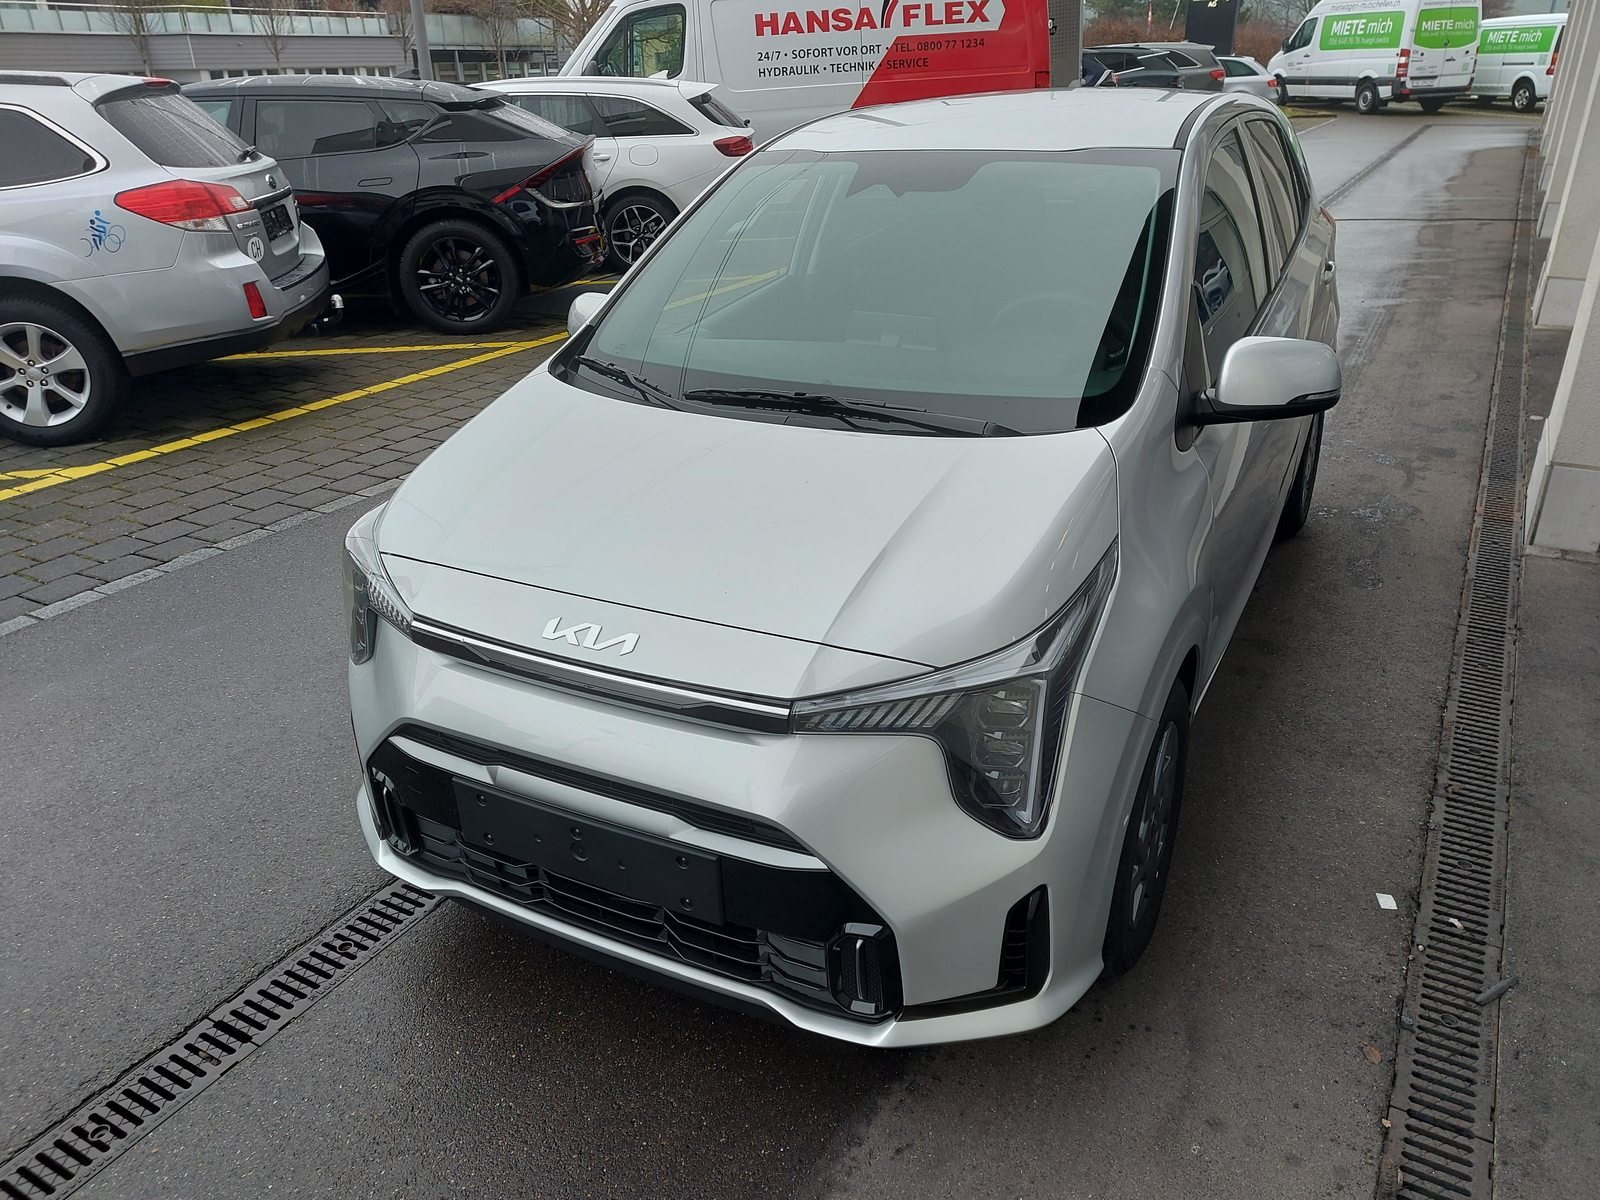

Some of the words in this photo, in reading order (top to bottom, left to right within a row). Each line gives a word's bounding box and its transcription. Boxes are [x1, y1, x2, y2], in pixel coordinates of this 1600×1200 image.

[754, 7, 878, 36] HANSA
[902, 0, 990, 28] FLEX
[1331, 19, 1367, 36] MIETE
[1366, 17, 1393, 34] mich
[1422, 20, 1454, 31] MIETE
[1455, 19, 1475, 30] mich
[1487, 30, 1519, 43] MIETE
[1519, 30, 1542, 42] mich
[757, 51, 781, 61] 24/7
[791, 47, 834, 59] SOFORT
[836, 46, 858, 56] VOR
[860, 44, 881, 55] ORT
[894, 42, 915, 53] TEL.
[917, 41, 942, 51] 0800
[945, 40, 957, 49] 77
[960, 38, 985, 48] 1234
[758, 64, 820, 77] HYDRAULIK
[830, 61, 875, 73] TECHNIK
[886, 57, 929, 70] SERVICE
[251, 240, 262, 258] CH
